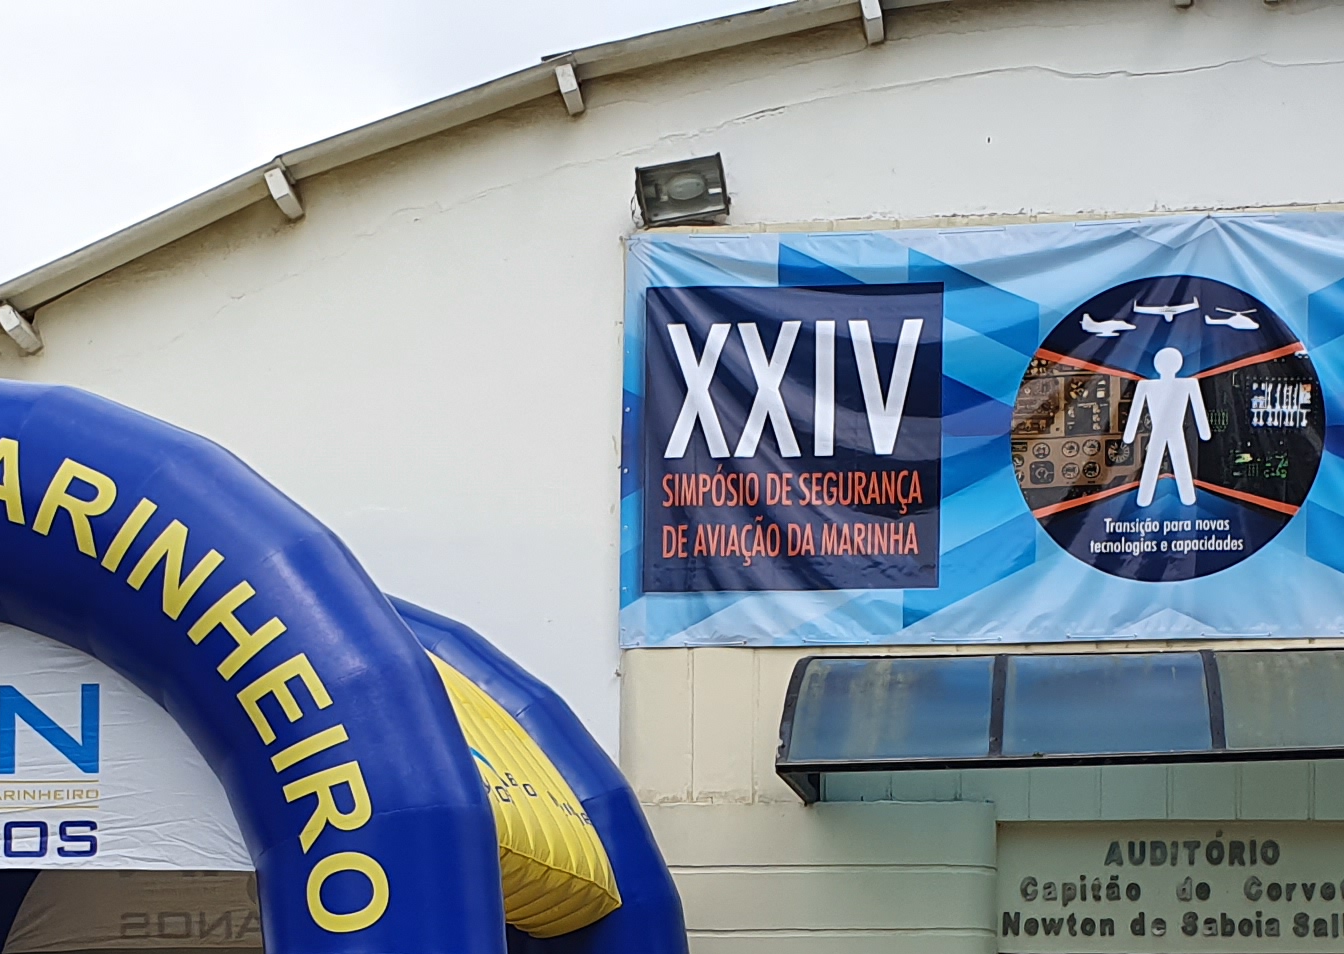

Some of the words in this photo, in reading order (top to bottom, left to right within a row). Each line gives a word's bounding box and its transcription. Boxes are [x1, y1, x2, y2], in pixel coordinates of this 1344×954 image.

[663, 319, 924, 458] XXIV
[662, 465, 759, 507] SIMPÓSIO
[766, 473, 793, 505] DE
[799, 470, 923, 515] SEGURANÇA
[662, 525, 688, 558] DE
[694, 516, 781, 566] AVIAÇÃO
[787, 523, 816, 556] DA
[821, 522, 919, 556] MARINHA
[1104, 517, 1160, 537] Transição
[1163, 521, 1192, 536] para
[1195, 518, 1230, 531] novas
[1090, 537, 1158, 556] tecnologias
[1160, 539, 1168, 552] e
[1171, 535, 1244, 554] capacidades
[1104, 829, 1281, 867] AUDITÓRIO
[1020, 875, 1142, 907] Capitão
[1002, 911, 1115, 937] Newton
[1130, 911, 1167, 937] de
[1181, 911, 1281, 938] Saboia
